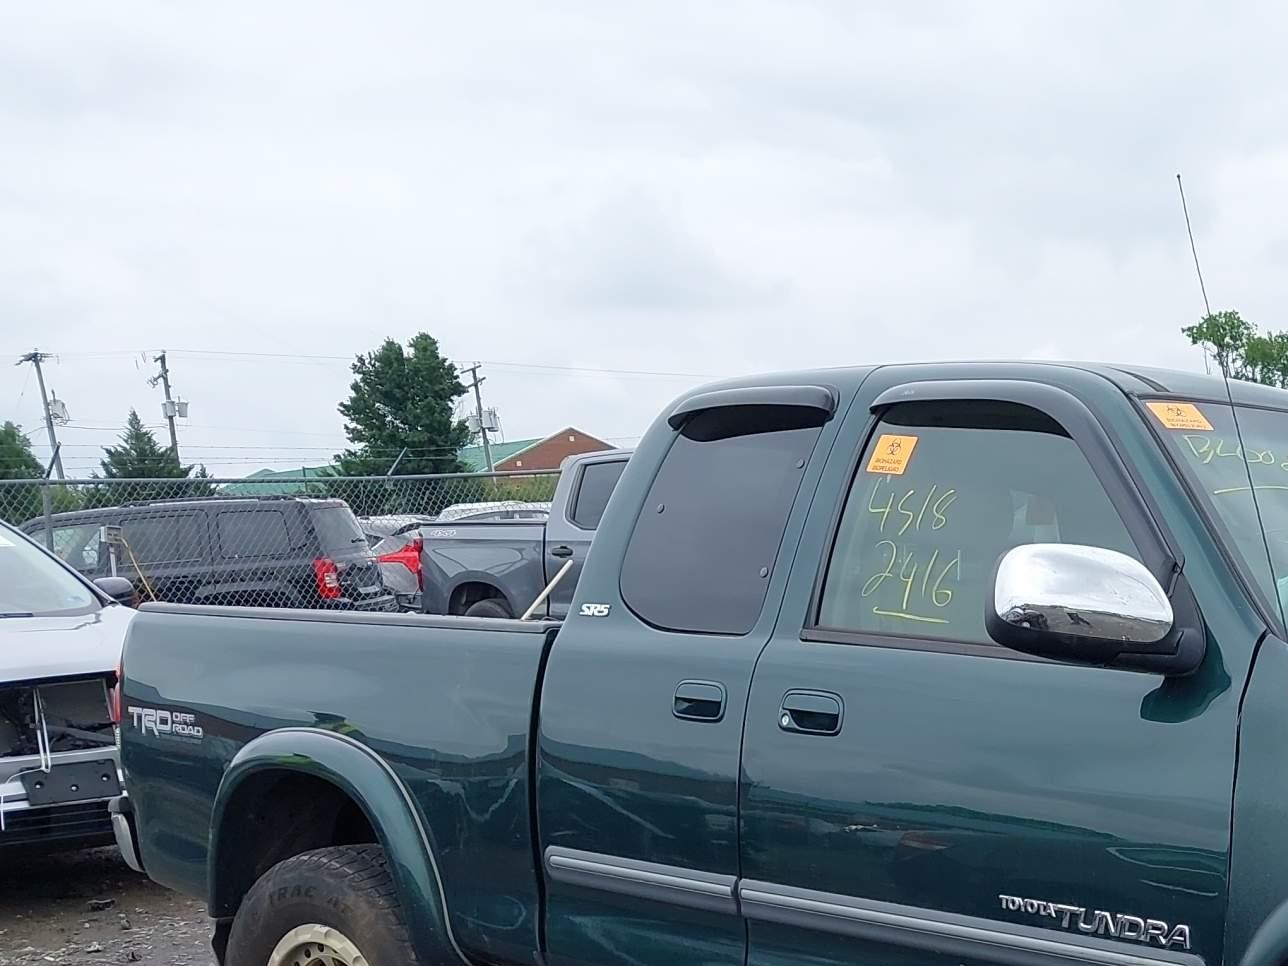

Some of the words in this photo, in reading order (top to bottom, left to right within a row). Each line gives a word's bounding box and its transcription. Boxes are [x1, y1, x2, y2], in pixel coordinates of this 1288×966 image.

[868, 477, 957, 536] 4518
[861, 540, 960, 610] 2416
[579, 603, 610, 617] SR5
[127, 705, 172, 737] TRD
[172, 712, 196, 723] OFF
[172, 723, 204, 737] ROAD
[999, 894, 1057, 918] TOYOTA
[1054, 904, 1192, 950] TUNDRA
